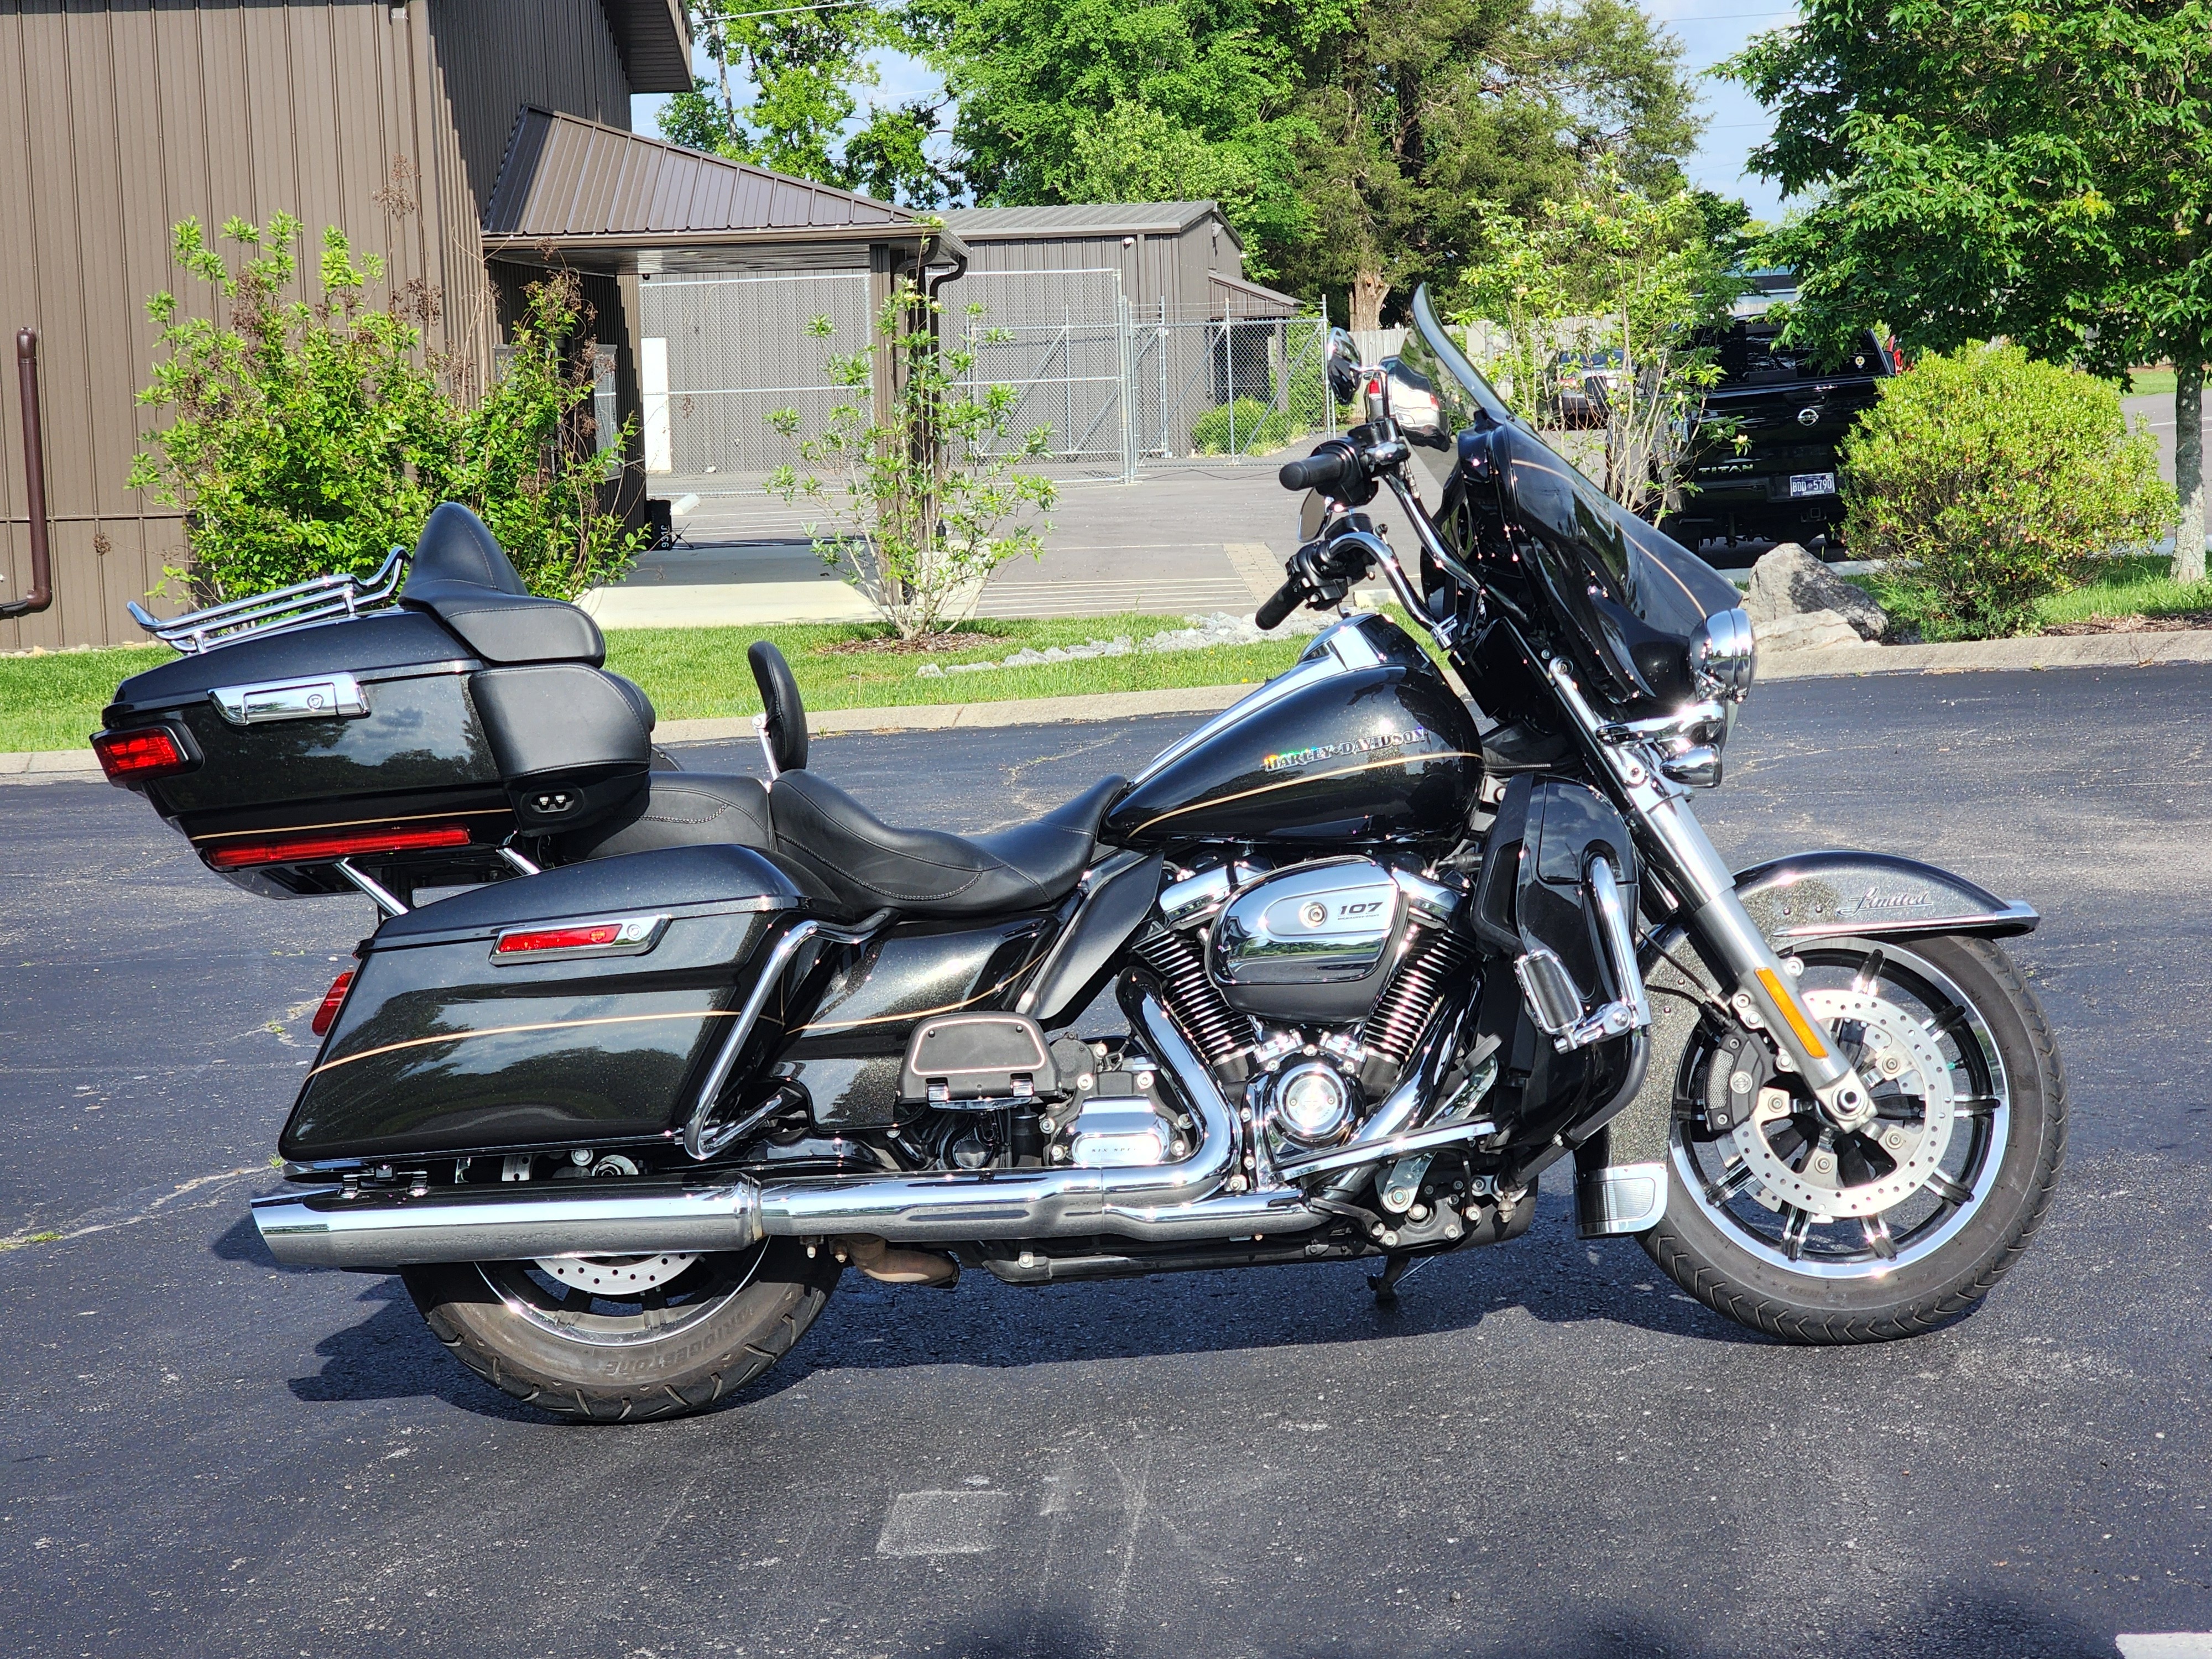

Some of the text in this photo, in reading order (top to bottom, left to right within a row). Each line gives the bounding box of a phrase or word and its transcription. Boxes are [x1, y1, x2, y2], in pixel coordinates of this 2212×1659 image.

[1698, 464, 1754, 474] TITAN
[1792, 479, 1832, 492] BDD 5790
[1340, 901, 1384, 915] 107
[1836, 886, 1934, 917] Limited
